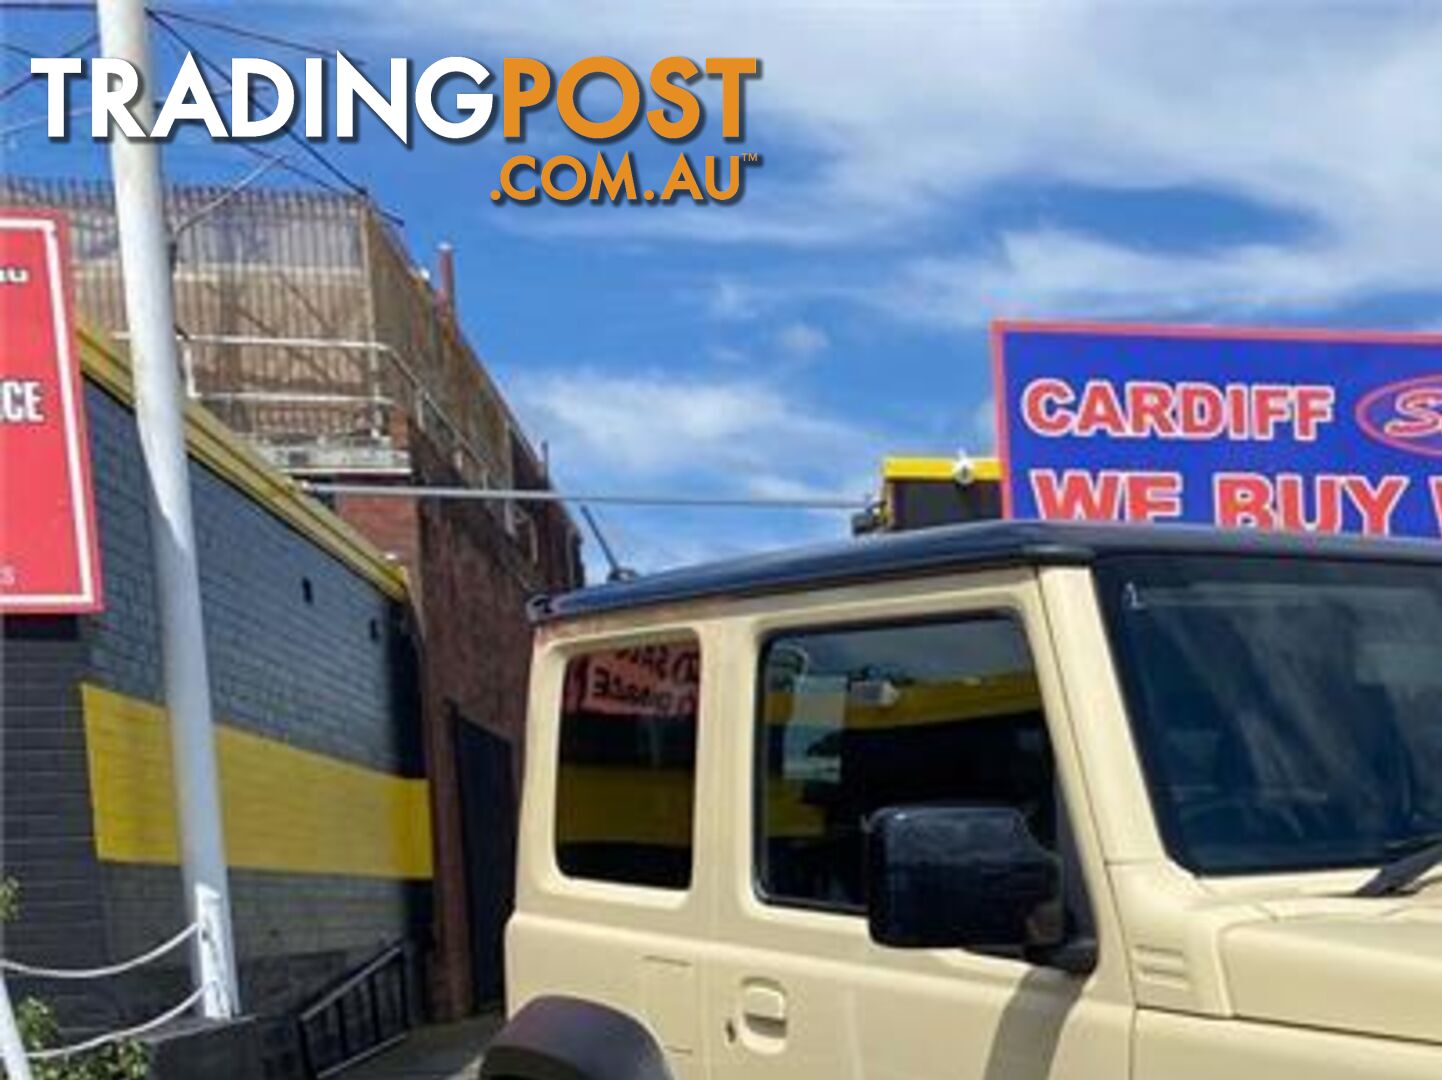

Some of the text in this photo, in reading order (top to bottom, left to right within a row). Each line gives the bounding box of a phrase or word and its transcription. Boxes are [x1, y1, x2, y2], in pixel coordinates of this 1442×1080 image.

[1022, 378, 1335, 441] CARDIFF
[1031, 469, 1182, 522] WE
[1214, 472, 1407, 535] BUY
